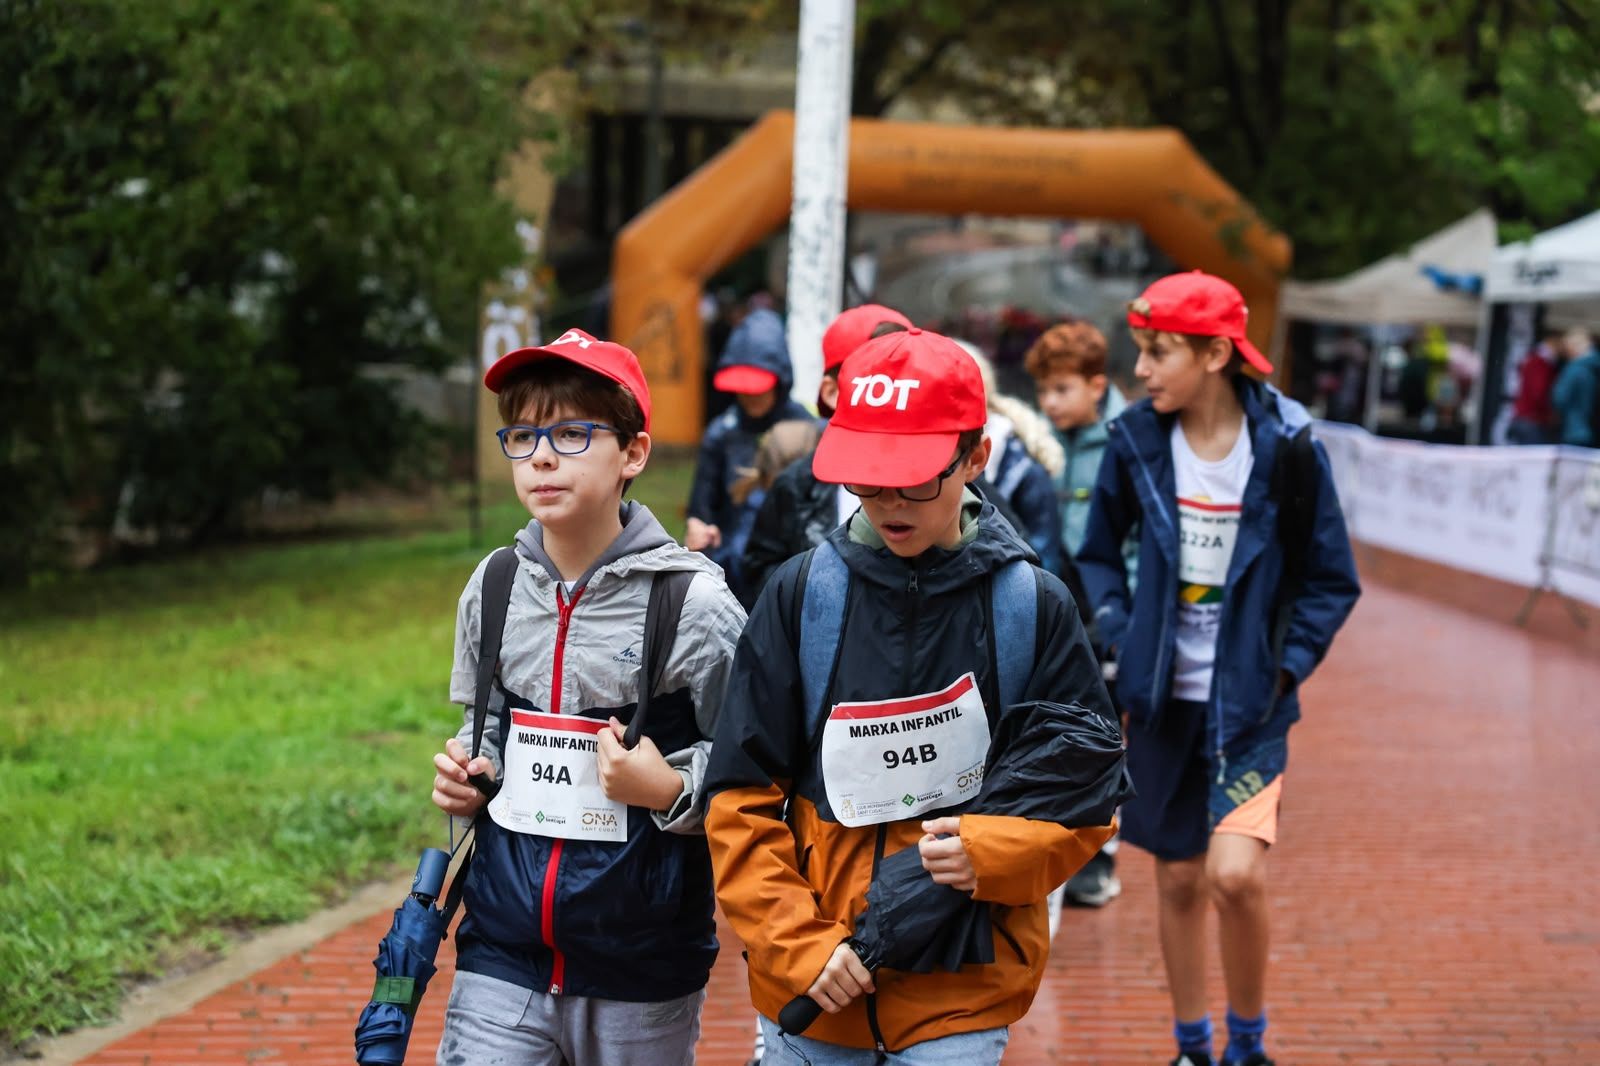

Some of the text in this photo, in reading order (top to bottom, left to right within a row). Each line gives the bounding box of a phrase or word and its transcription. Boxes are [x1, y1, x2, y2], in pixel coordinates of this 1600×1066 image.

[850, 373, 920, 411] TOT
[849, 706, 963, 738] MARXA INFANTIL
[517, 731, 548, 748] MARXA
[882, 743, 938, 769] 94B
[531, 762, 573, 786] 94A
[581, 812, 618, 827] ONA
